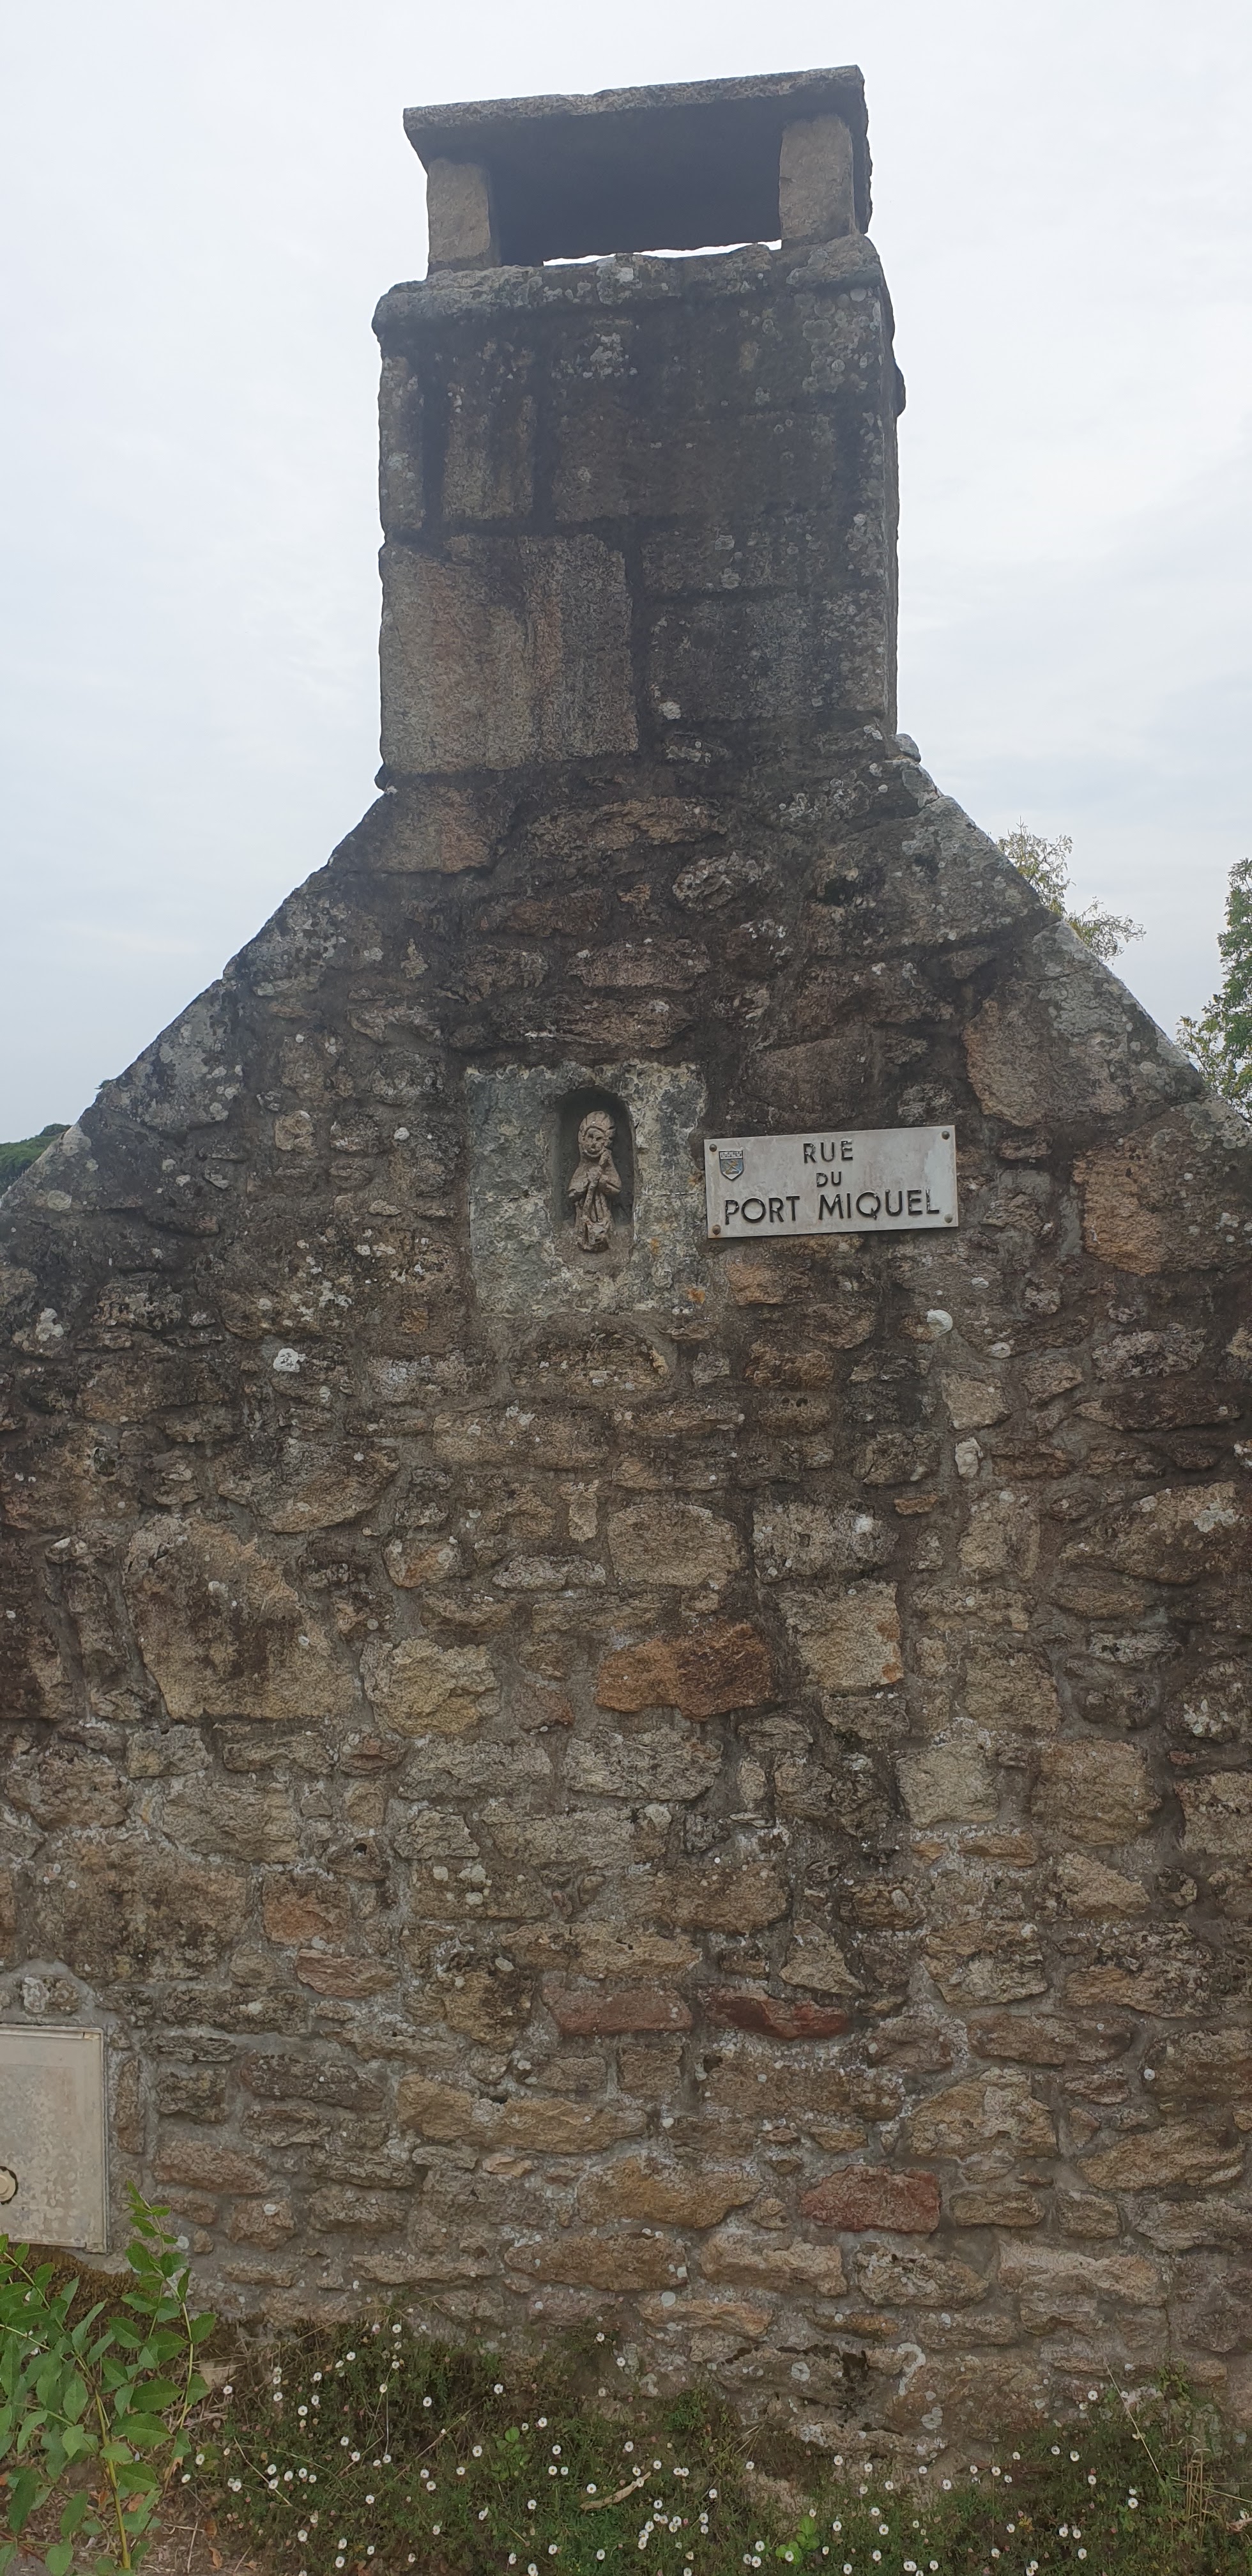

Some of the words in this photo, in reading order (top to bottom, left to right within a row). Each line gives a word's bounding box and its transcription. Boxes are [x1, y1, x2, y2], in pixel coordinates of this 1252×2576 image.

[803, 1140, 853, 1164] RUE
[816, 1170, 842, 1188] DU
[725, 1195, 800, 1225] PORT
[818, 1188, 940, 1220] MIQUEL
